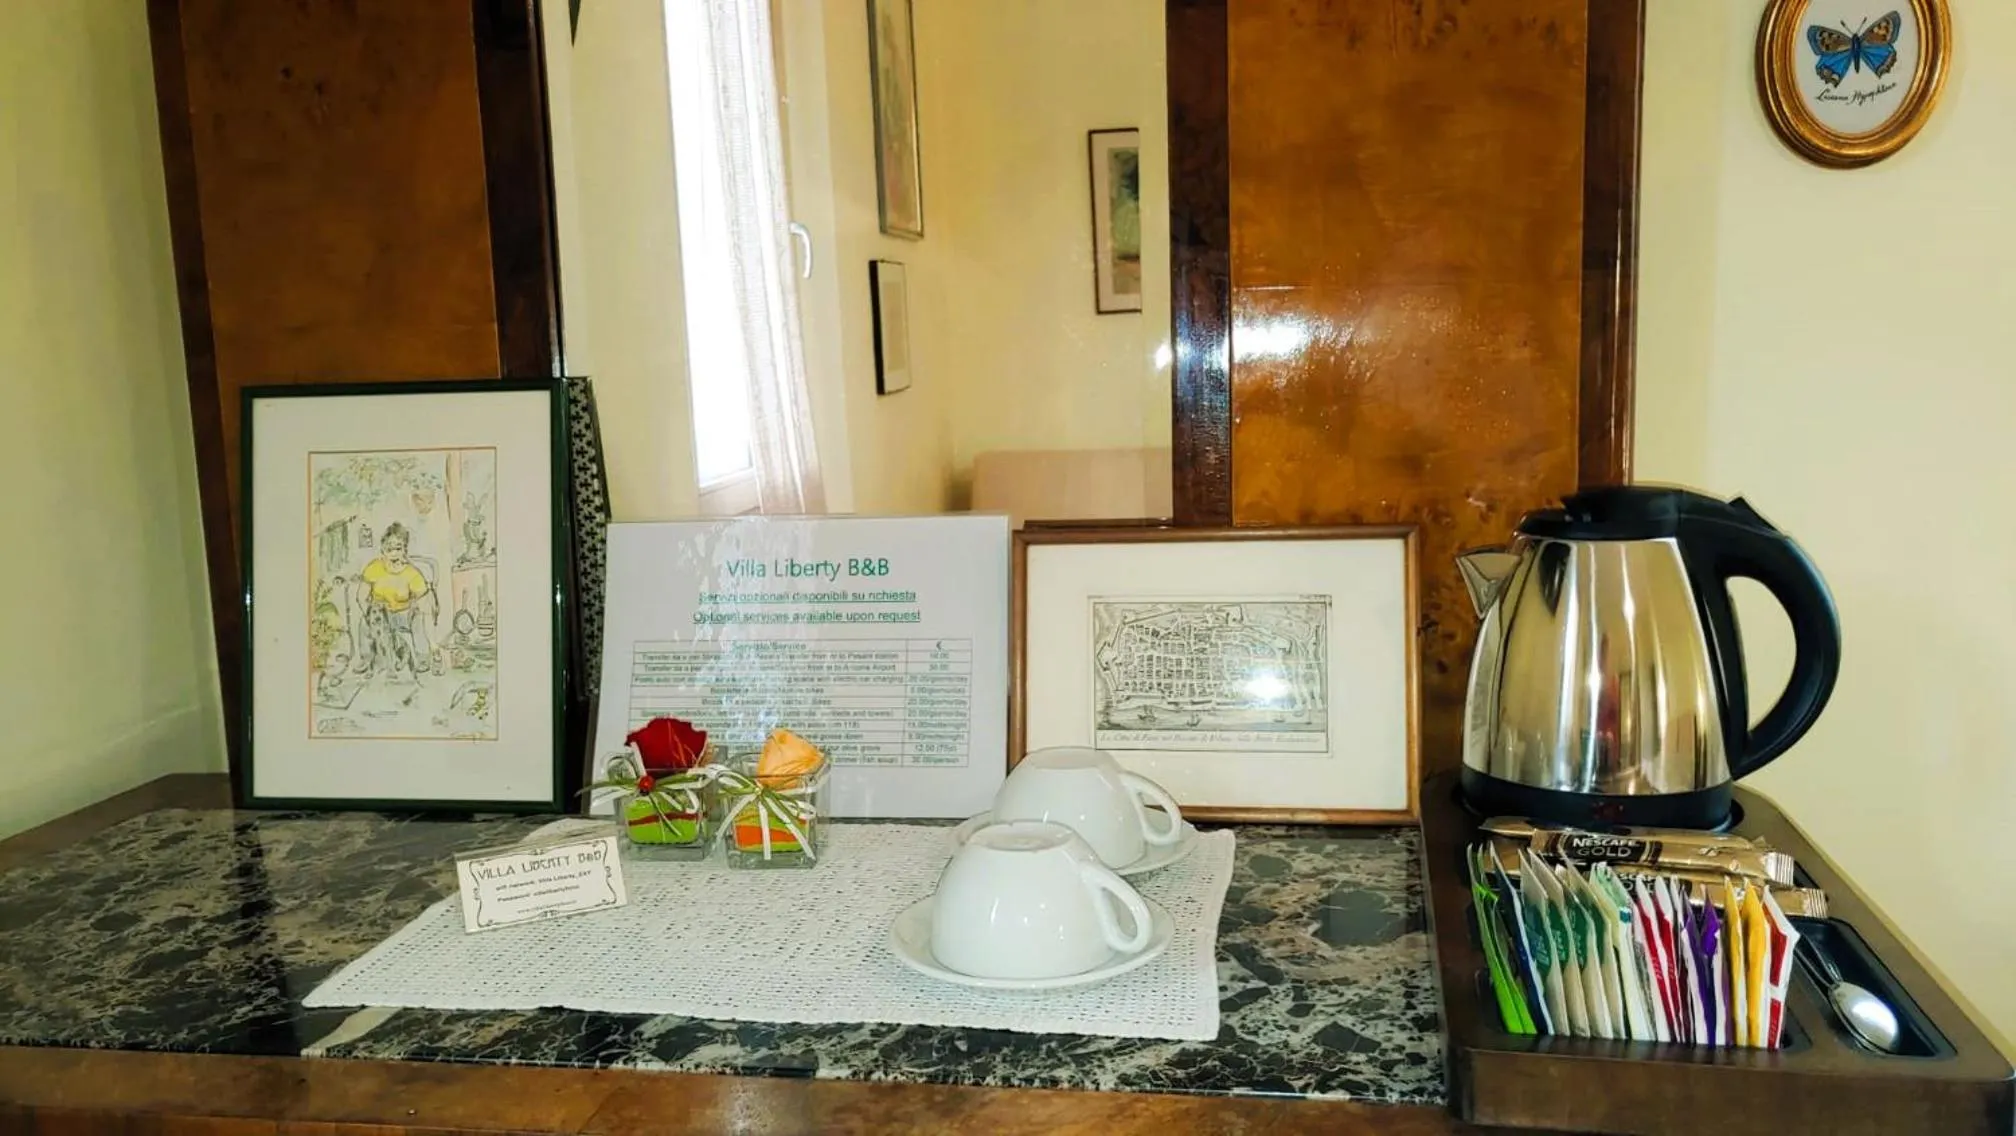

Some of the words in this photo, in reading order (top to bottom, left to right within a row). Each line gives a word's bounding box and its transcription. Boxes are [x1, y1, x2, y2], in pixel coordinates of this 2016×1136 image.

[726, 558, 767, 578] Villa
[774, 558, 841, 582] Liberty
[848, 558, 890, 577] B&B
[851, 591, 866, 601] su
[792, 610, 843, 622] available
[846, 612, 875, 624] upon
[878, 610, 921, 624] request
[1577, 846, 1633, 858] GOLD
[477, 865, 516, 881] VILLA
